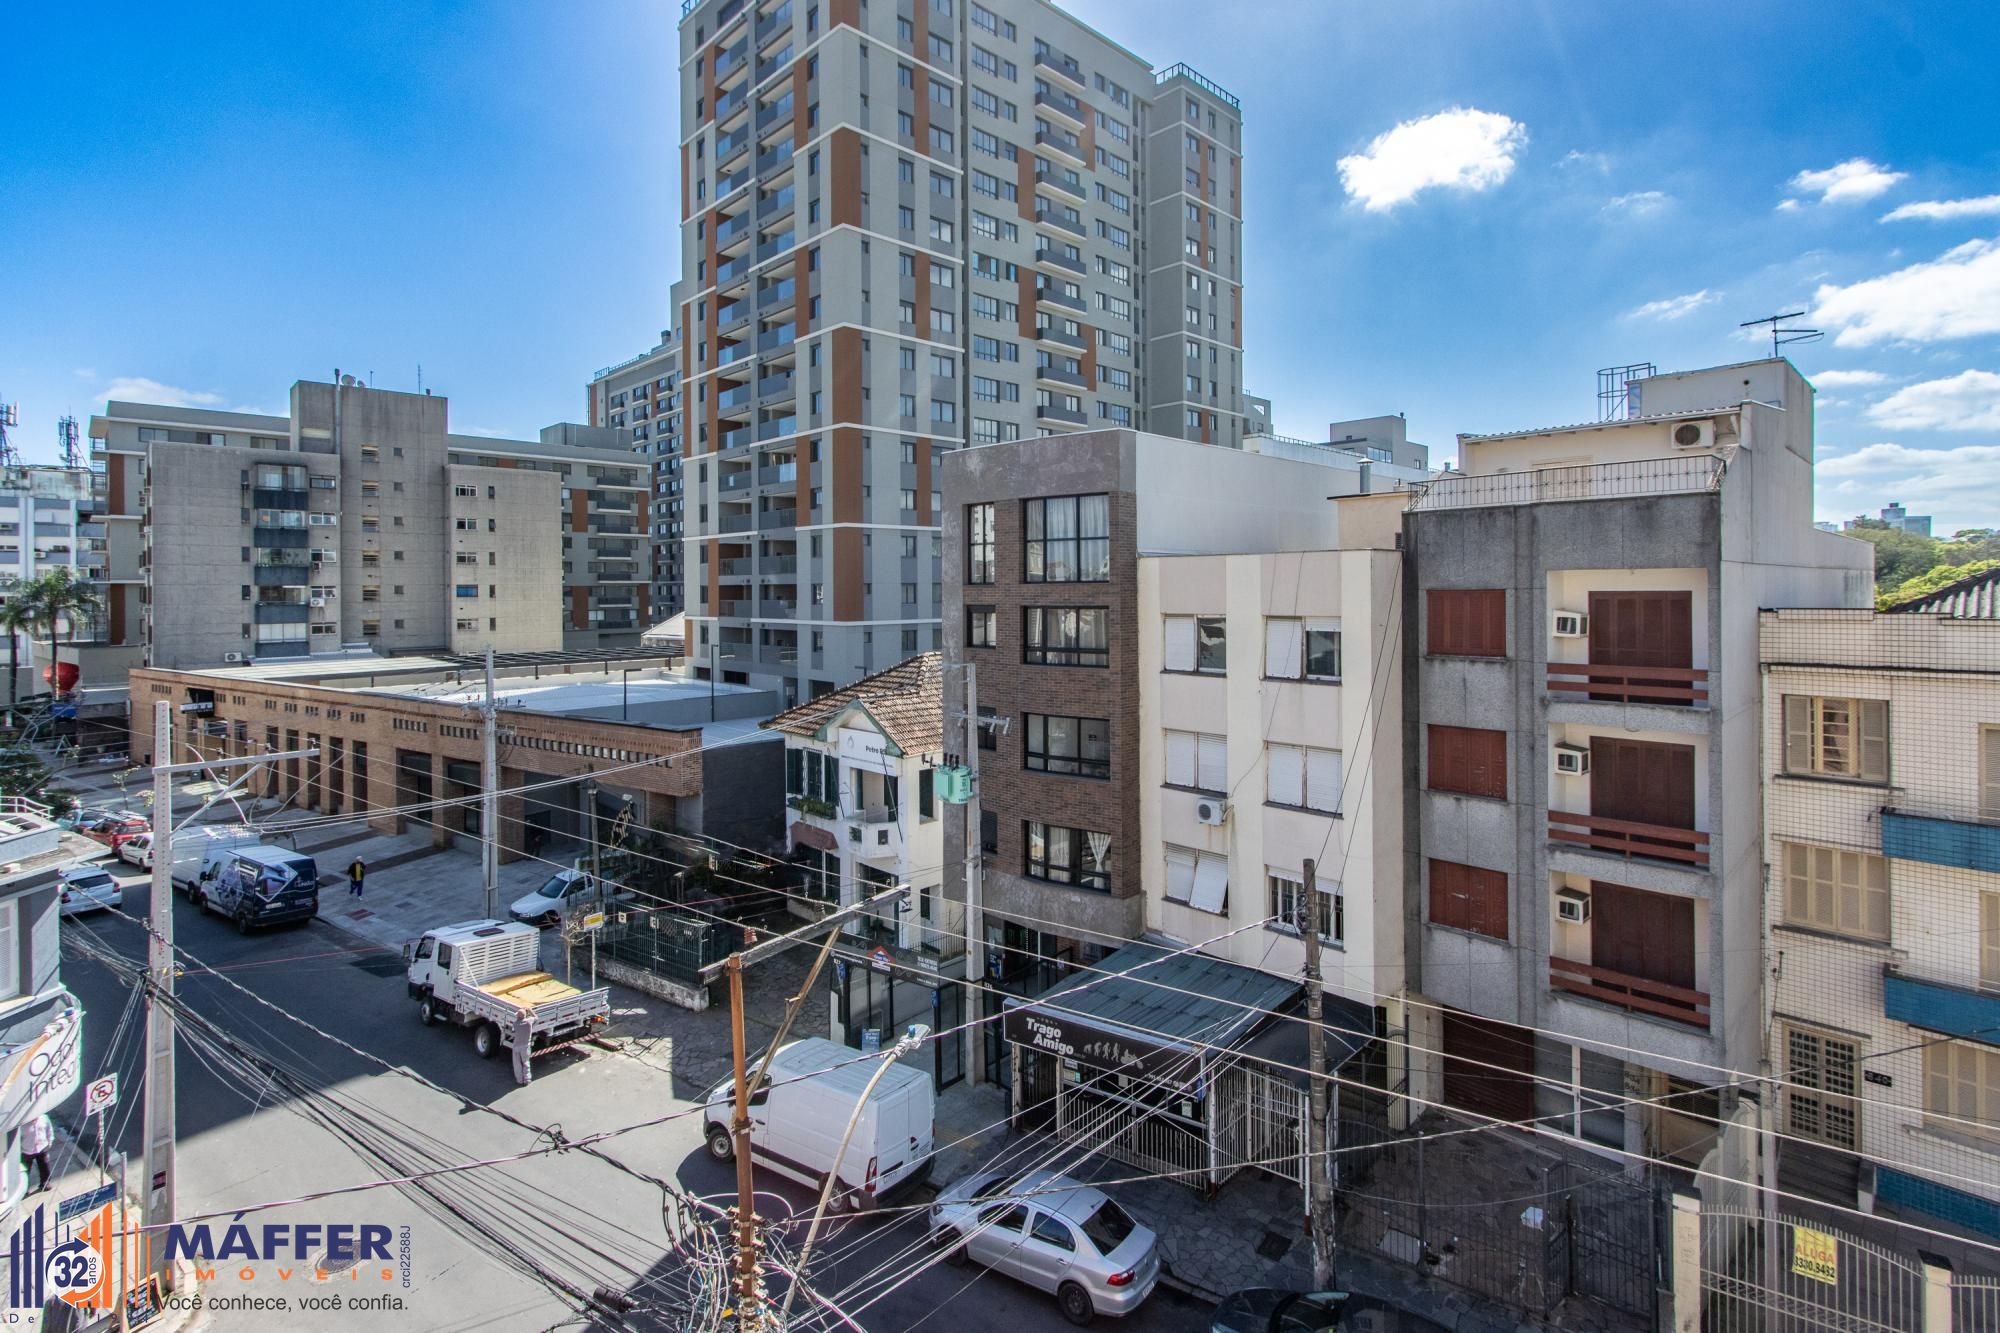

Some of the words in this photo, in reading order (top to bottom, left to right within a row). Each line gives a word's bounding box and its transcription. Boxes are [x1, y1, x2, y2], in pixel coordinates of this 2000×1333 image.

[865, 745, 879, 754] Petro
[1026, 1017, 1062, 1038] Trago
[1033, 1033, 1074, 1056] Amigo
[1796, 1244, 1835, 1264] ALUGA
